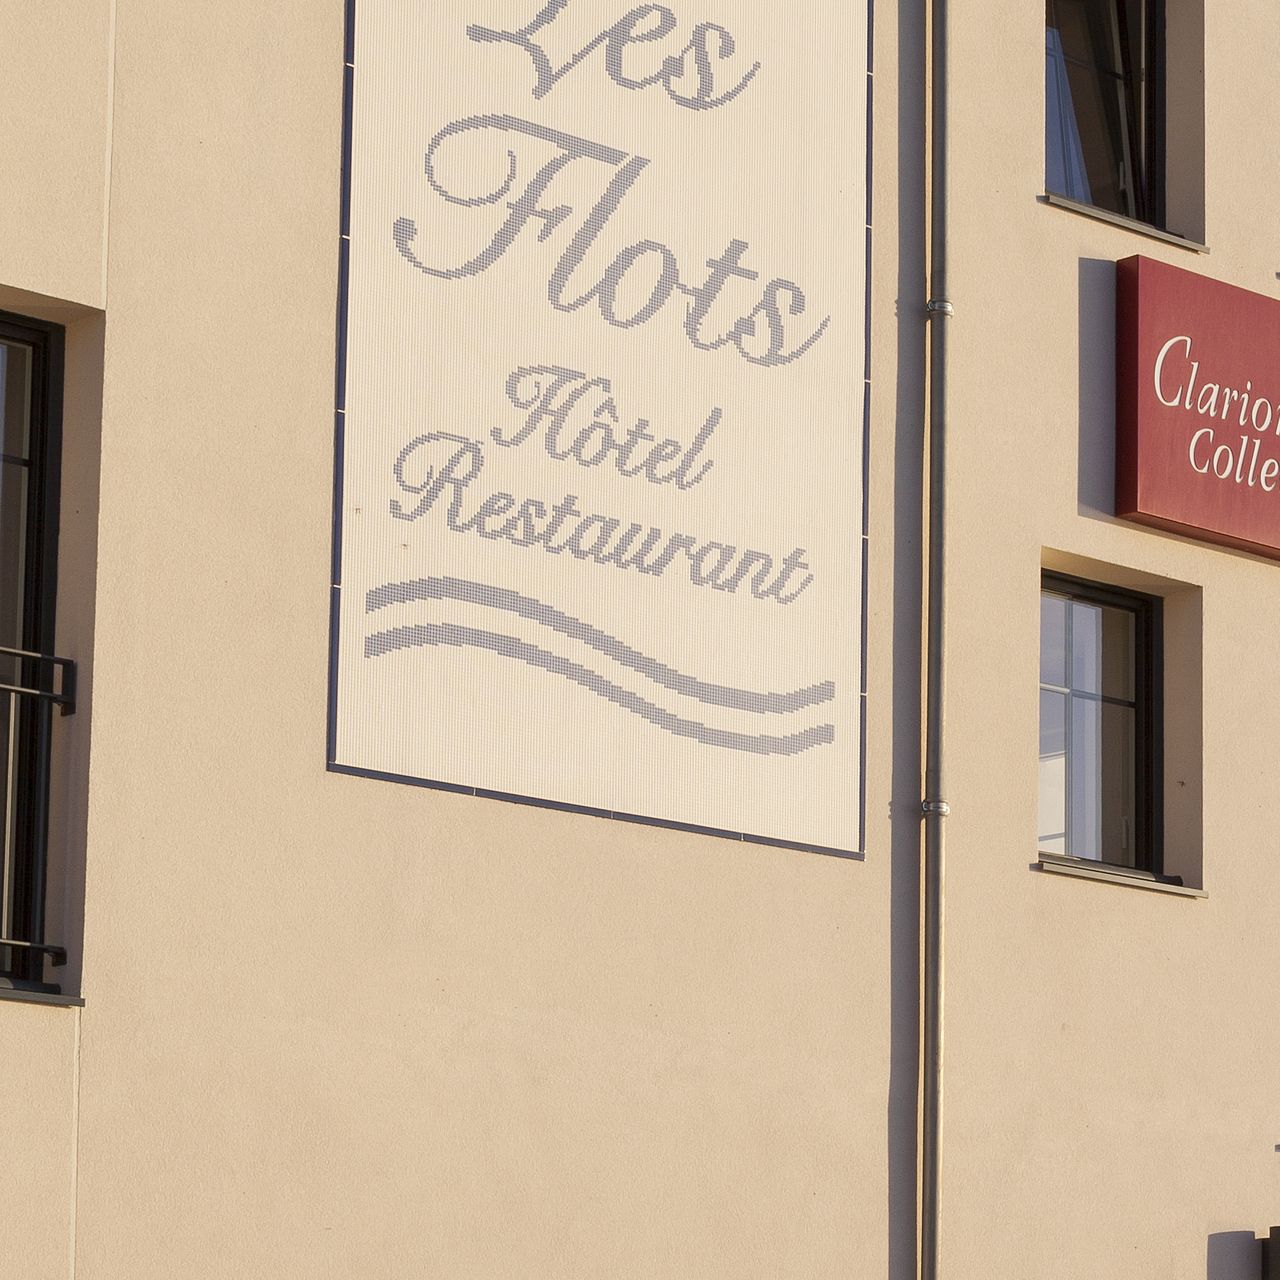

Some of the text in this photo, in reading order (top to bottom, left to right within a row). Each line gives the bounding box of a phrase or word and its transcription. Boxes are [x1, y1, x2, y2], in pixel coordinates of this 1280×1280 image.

[392, 113, 831, 368] Flots
[490, 365, 723, 490] Hôtel
[389, 431, 815, 605] Restaurant
